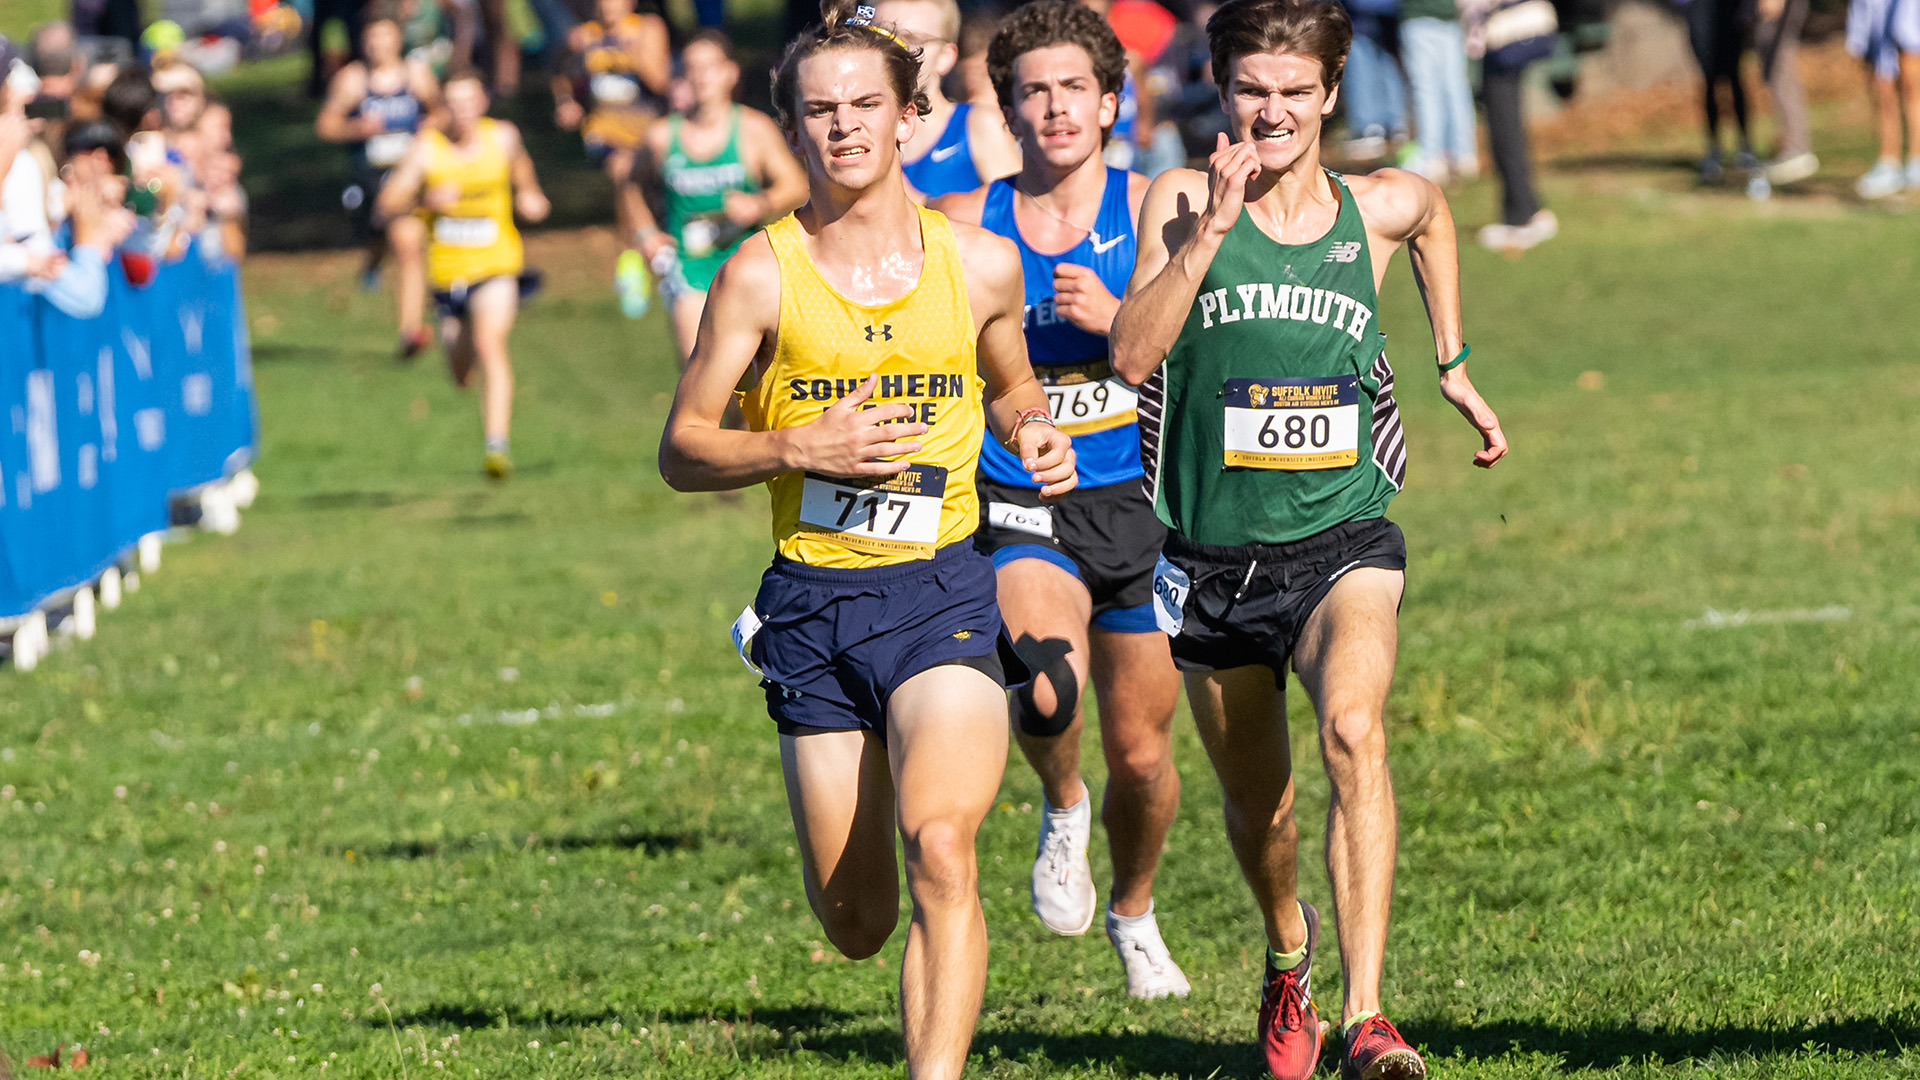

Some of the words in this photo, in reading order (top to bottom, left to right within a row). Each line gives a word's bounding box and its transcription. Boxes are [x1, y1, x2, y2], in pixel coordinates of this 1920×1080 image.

[1198, 283, 1373, 343] PLYMOUTH
[1047, 385, 1109, 419] 769
[1271, 386, 1310, 397] SUFFOLK
[1312, 384, 1339, 395] INVITE
[1257, 414, 1330, 449] 680
[1242, 454, 1266, 462] SUFFOLK
[1305, 455, 1342, 463] INVITATIONAL
[833, 489, 911, 535] 717
[840, 535, 875, 547] UNIVERSITY
[877, 543, 918, 552] INVITATIONAL
[1154, 575, 1179, 608] 680
